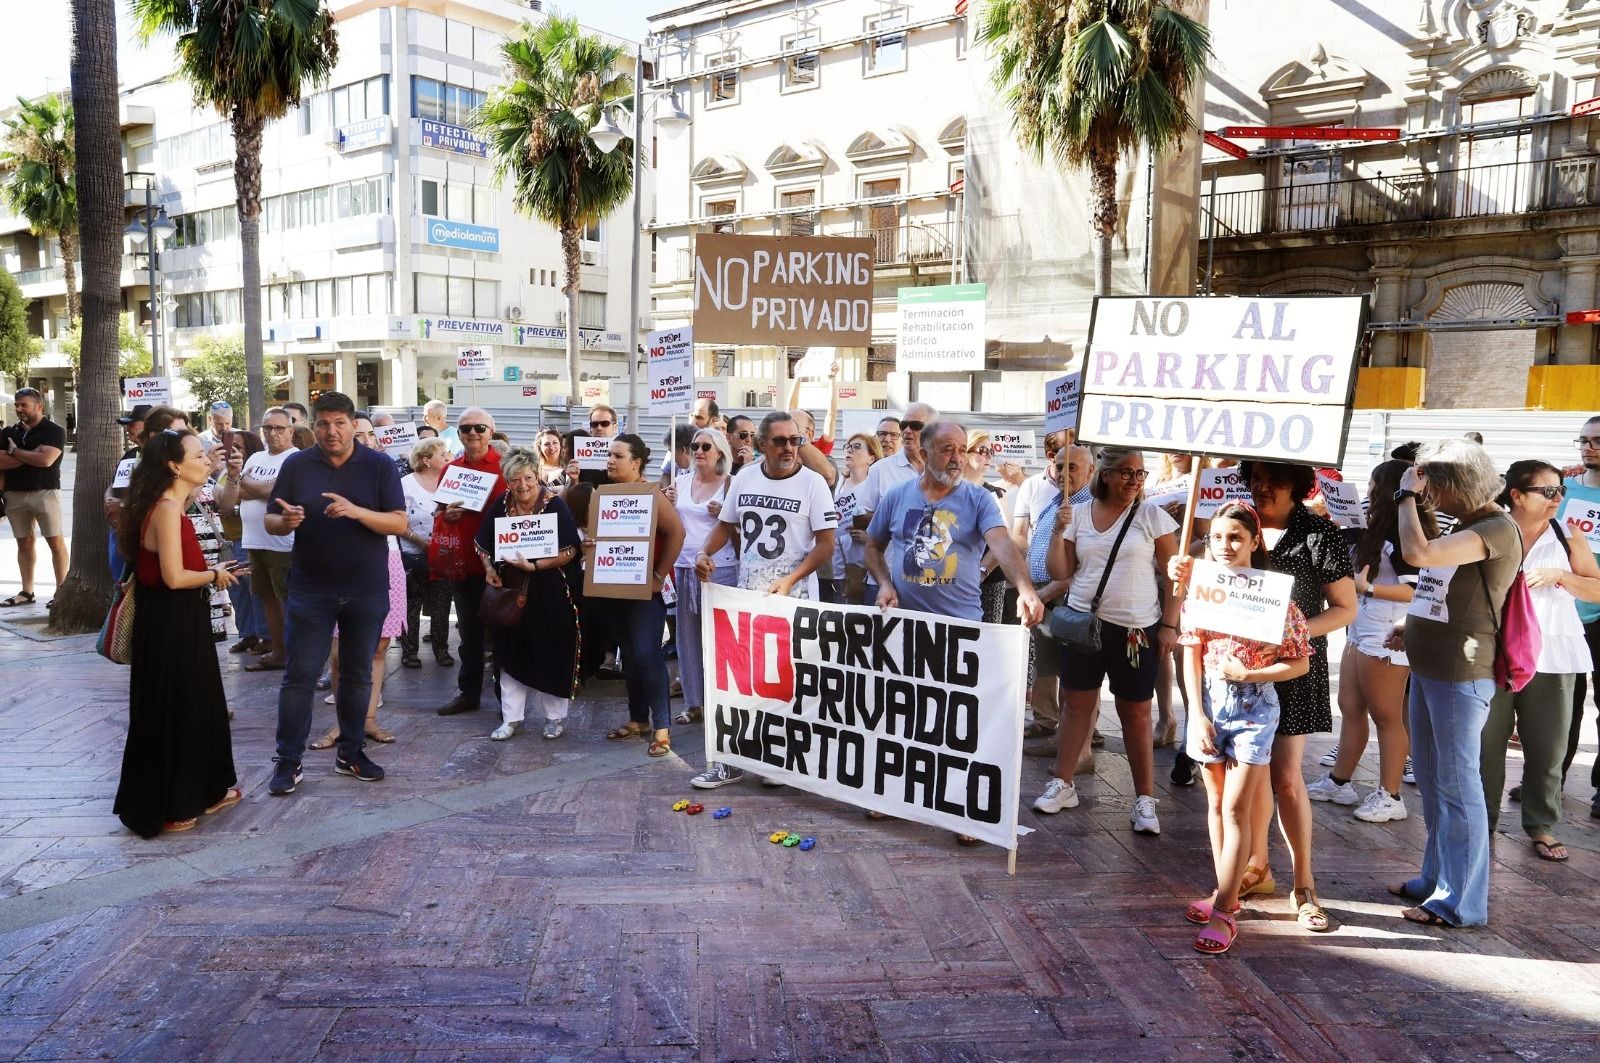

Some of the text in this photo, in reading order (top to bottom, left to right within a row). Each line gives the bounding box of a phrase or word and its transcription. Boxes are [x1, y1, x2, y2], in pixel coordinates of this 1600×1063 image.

[438, 135, 481, 152] PRIVADOS
[434, 225, 496, 244] mediolanum
[752, 249, 870, 285] PARKING
[695, 255, 750, 311] NO
[751, 296, 869, 332] PRIVADO
[903, 307, 964, 319] Terminación
[438, 319, 503, 333] PREVENTIVA
[1129, 300, 1297, 341] NO AL
[462, 333, 503, 344] SEGUROS
[659, 333, 681, 344] STOP!
[902, 335, 937, 346] Edificio
[651, 346, 665, 358] NO
[902, 349, 976, 359] Administrativo
[458, 358, 467, 366] NO
[1092, 350, 1335, 395] PARKING
[660, 376, 682, 386] STOP!
[1056, 380, 1076, 395] STOP!
[128, 390, 144, 398] NO
[652, 388, 666, 400] NO
[1048, 398, 1061, 413] NO
[384, 427, 405, 436] STOP!
[1097, 399, 1314, 454] PRIVADO
[586, 440, 608, 448] STOP!
[994, 434, 1020, 443] STOP!
[577, 449, 592, 457] NO
[458, 472, 482, 484] STOP!
[443, 479, 460, 490] NO
[1200, 488, 1224, 500] NO
[612, 498, 638, 508] STOP!
[740, 495, 799, 511] NX FVTVRE
[602, 510, 618, 520] NO
[511, 520, 540, 530] STOP!
[1567, 516, 1594, 532] NO
[498, 532, 519, 544] NO
[742, 510, 787, 560] 93
[609, 545, 634, 554] STOP!
[598, 556, 614, 567] NO
[1216, 573, 1264, 592] STOP!
[1196, 586, 1226, 604] NO
[1229, 591, 1281, 606] AL PARKING
[1228, 600, 1266, 613] PRIVADO
[792, 606, 980, 688] PARKING
[712, 608, 794, 703] NO
[792, 662, 979, 754] PRIVADO
[715, 703, 1002, 825] HUERTO PACO
